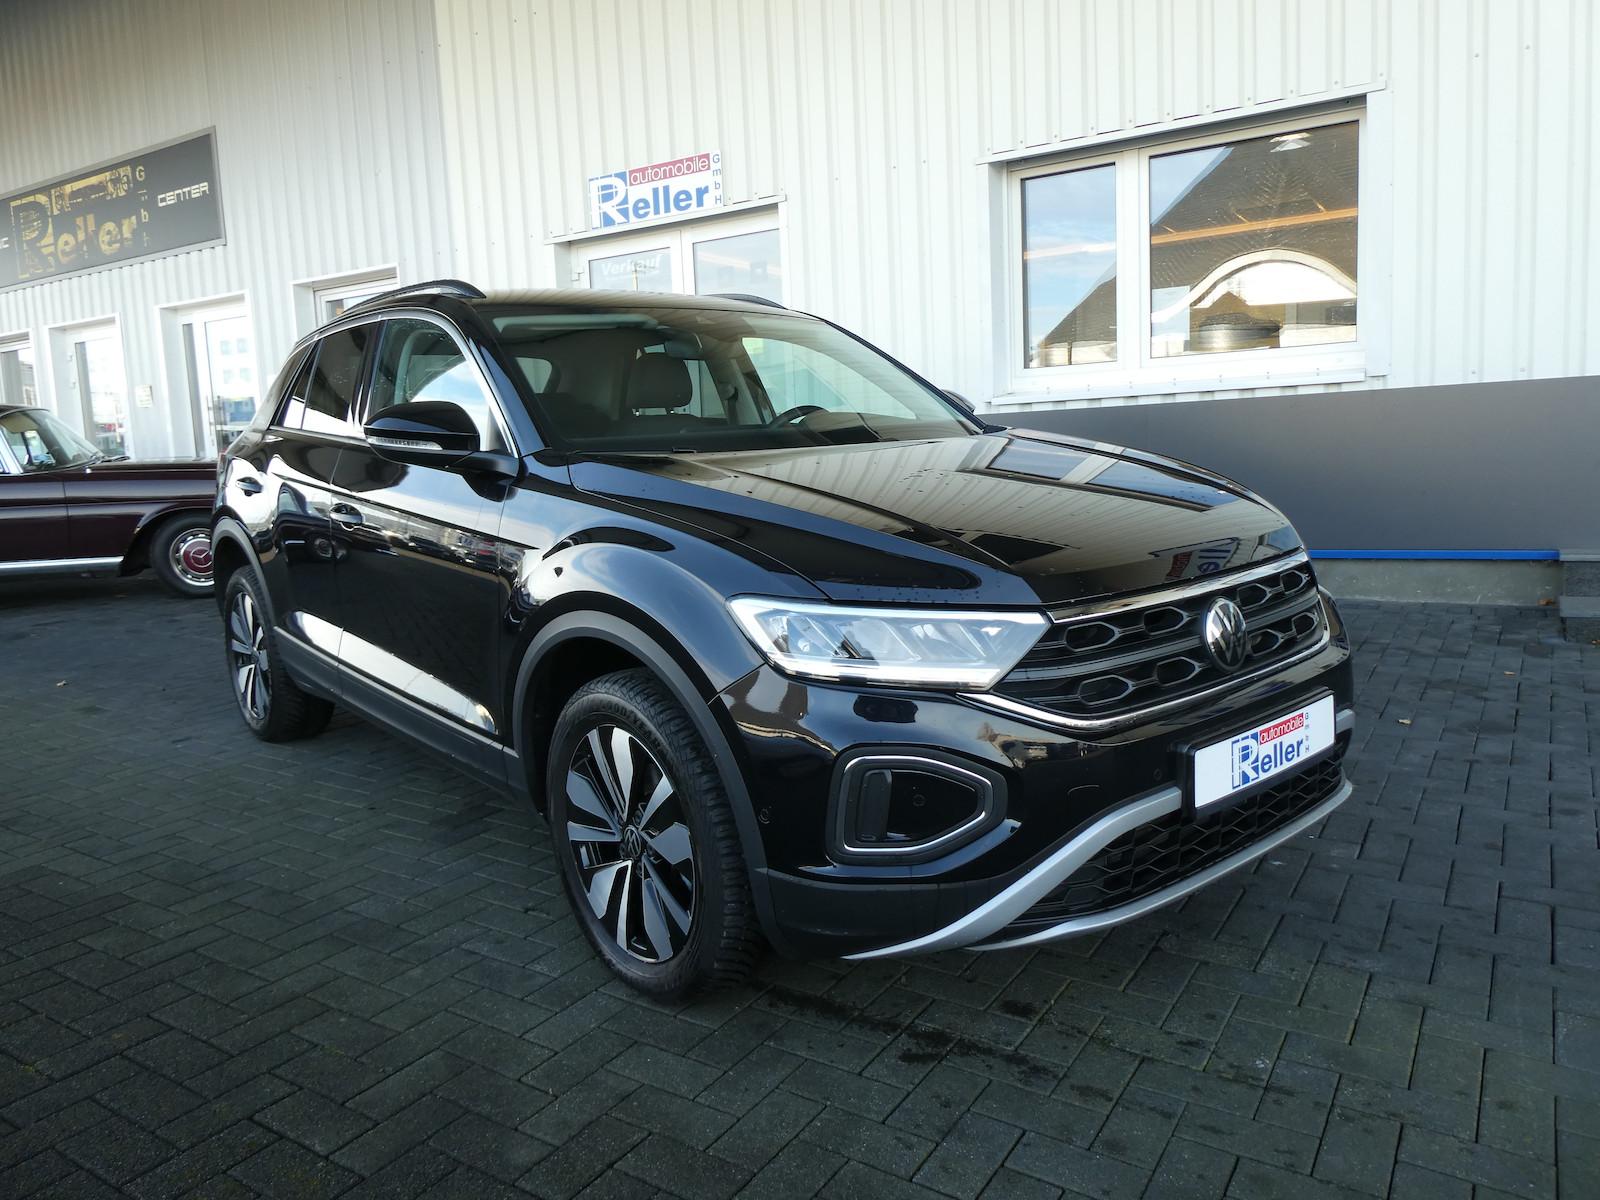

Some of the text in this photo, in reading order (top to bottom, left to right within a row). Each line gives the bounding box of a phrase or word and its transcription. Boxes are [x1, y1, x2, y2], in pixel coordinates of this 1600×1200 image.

[630, 154, 709, 185] automobile
[157, 182, 209, 207] CENTER
[589, 171, 710, 229] Reller
[1259, 713, 1304, 744] automobile
[1232, 732, 1304, 789] Reller
